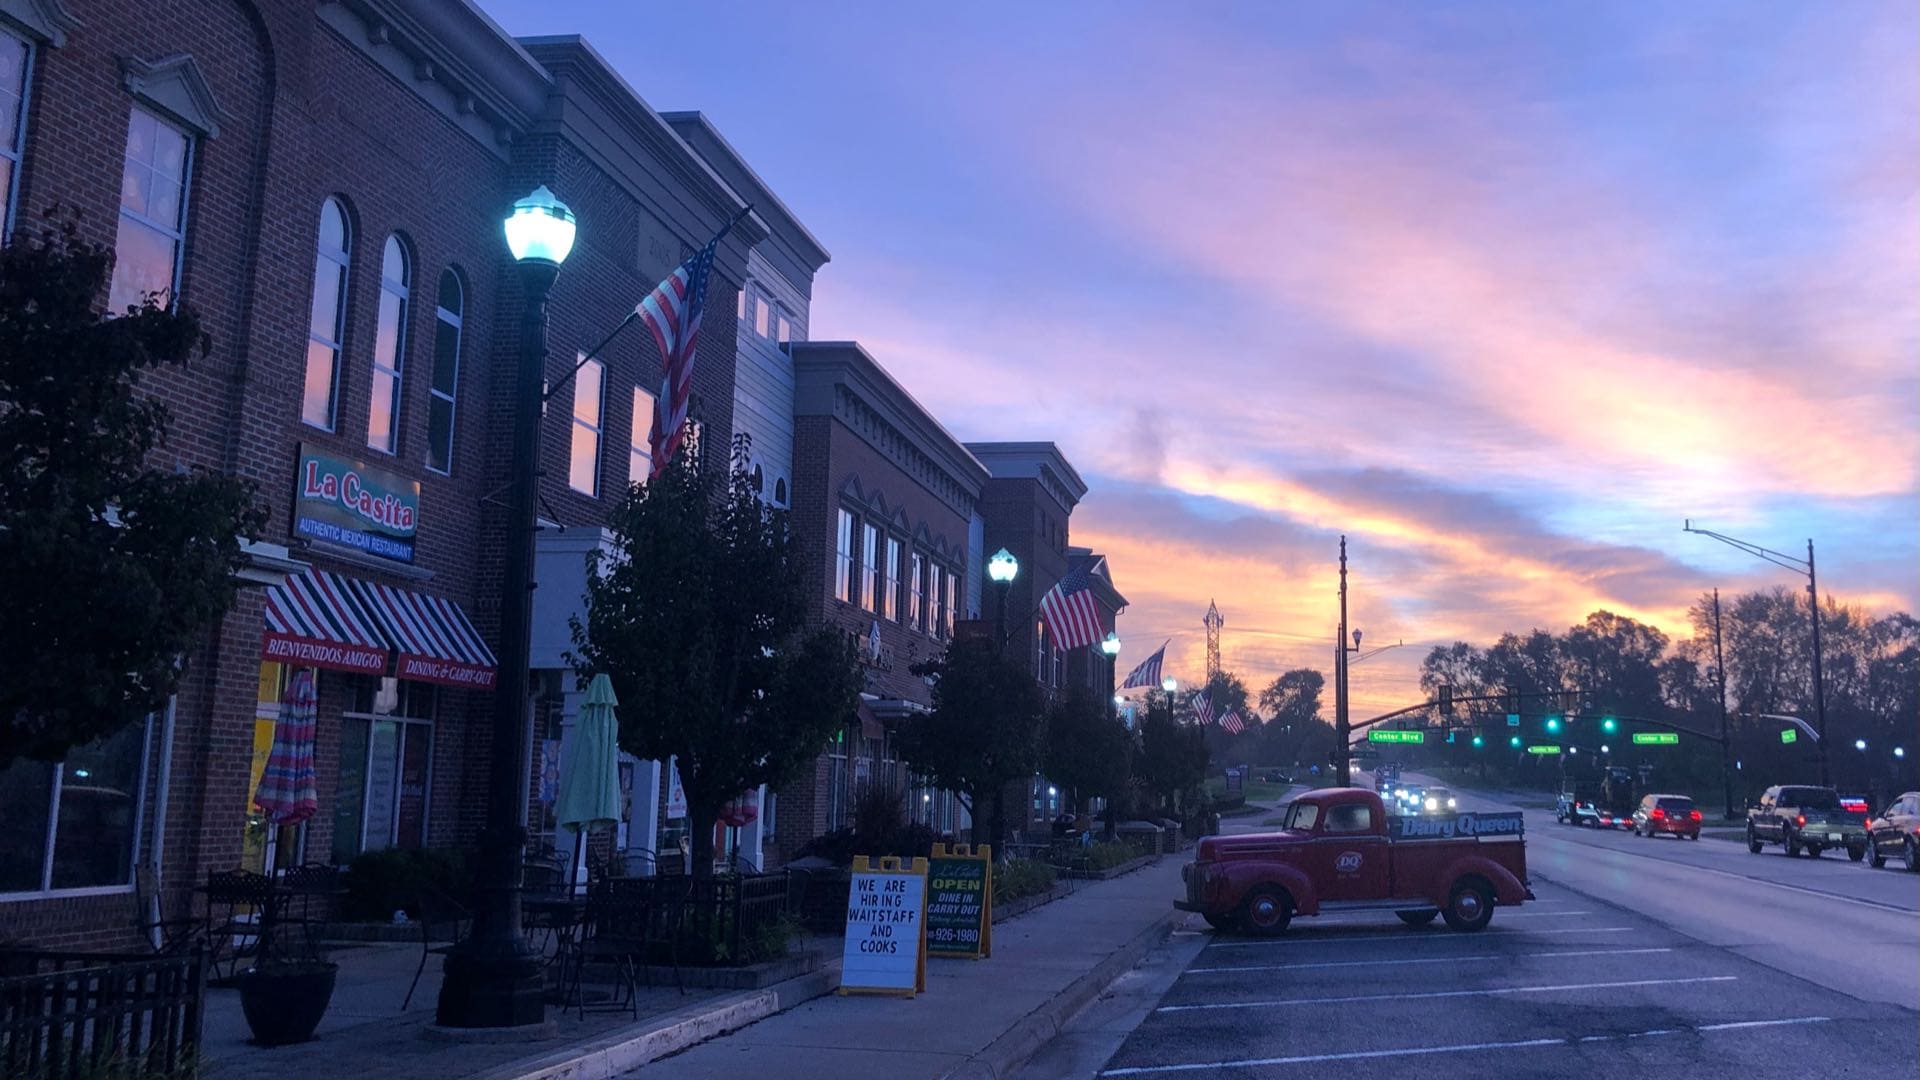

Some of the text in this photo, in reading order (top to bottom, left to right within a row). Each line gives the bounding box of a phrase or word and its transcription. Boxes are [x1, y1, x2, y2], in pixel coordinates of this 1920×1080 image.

[304, 459, 415, 531] La Casita
[299, 518, 413, 560] AUTHENTIC MEXICAN RESTAURANT
[266, 638, 383, 669] BIENVENIDOS AMIGOS
[405, 659, 494, 685] DINING & CARRY-OUT
[1373, 732, 1419, 740] Center Blvd
[1400, 814, 1520, 838] Dairy Queen
[1340, 855, 1360, 867] DQ
[858, 879, 906, 893] WE ARE
[932, 878, 980, 891] OPEN
[860, 894, 902, 907] HIRING
[938, 892, 974, 904] DINE IN
[849, 909, 915, 923] WAITSTAFF
[927, 904, 980, 915] CARRY OUT
[870, 925, 892, 938] AND
[860, 939, 898, 954] COOKS
